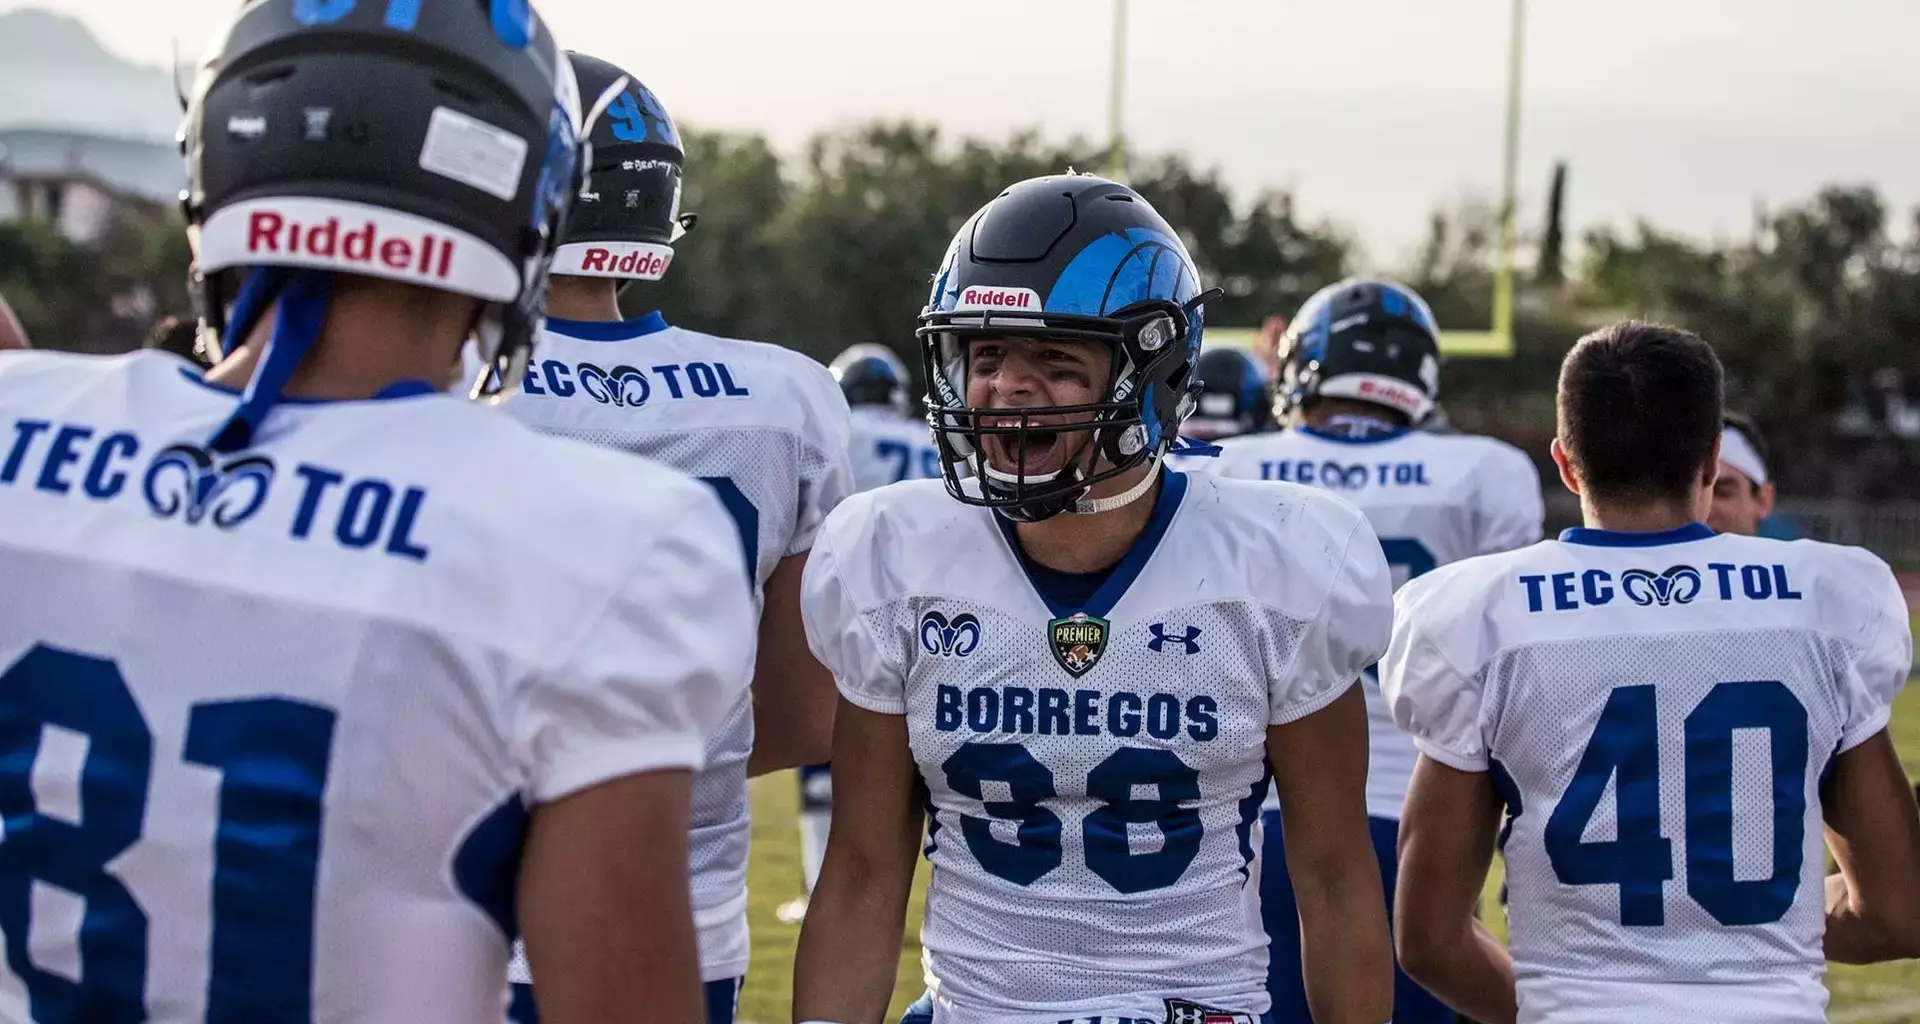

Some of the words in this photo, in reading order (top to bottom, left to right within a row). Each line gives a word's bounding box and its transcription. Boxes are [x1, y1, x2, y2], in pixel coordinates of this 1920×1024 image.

[247, 210, 453, 277] Riddell
[964, 290, 1030, 308] Riddell
[523, 359, 577, 397] EC
[651, 362, 750, 399] TOL
[0, 420, 140, 500] TEC
[289, 461, 430, 563] TOL
[1260, 461, 1315, 483] TEC
[1377, 463, 1431, 486] TOL
[1519, 569, 1614, 613] TEC
[1708, 563, 1802, 601] TOL
[1056, 627, 1101, 642] PREMIER
[935, 684, 1219, 742] BORREGOS
[1544, 680, 1809, 927] 40
[0, 640, 339, 1024] 81
